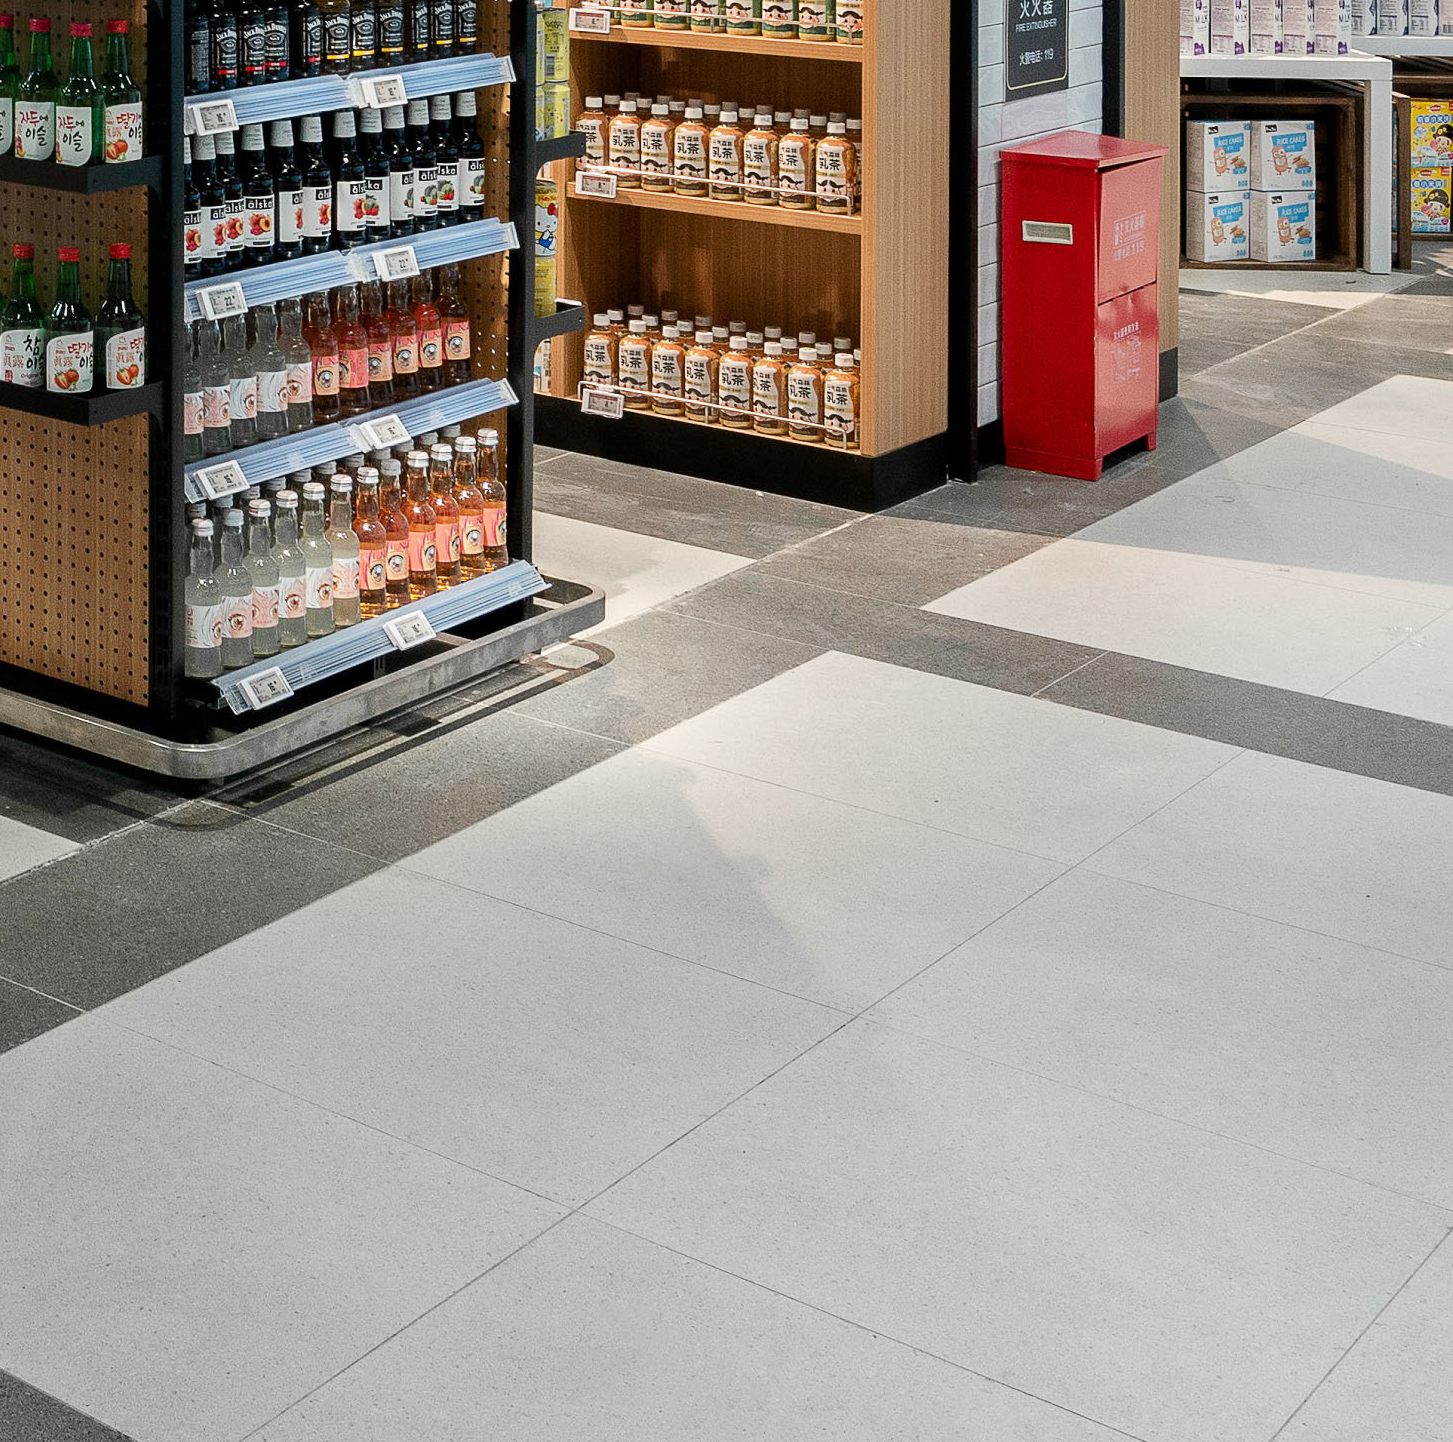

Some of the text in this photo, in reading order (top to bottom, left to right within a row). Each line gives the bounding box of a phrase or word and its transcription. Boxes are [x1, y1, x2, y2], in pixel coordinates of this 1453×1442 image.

[1015, 23, 1027, 33] FIRE
[19, 110, 49, 124] 자두에
[25, 125, 47, 146] 이슬
[62, 130, 84, 153] 이슬
[677, 141, 699, 155] 乳茶
[723, 372, 745, 387] 乳茶
